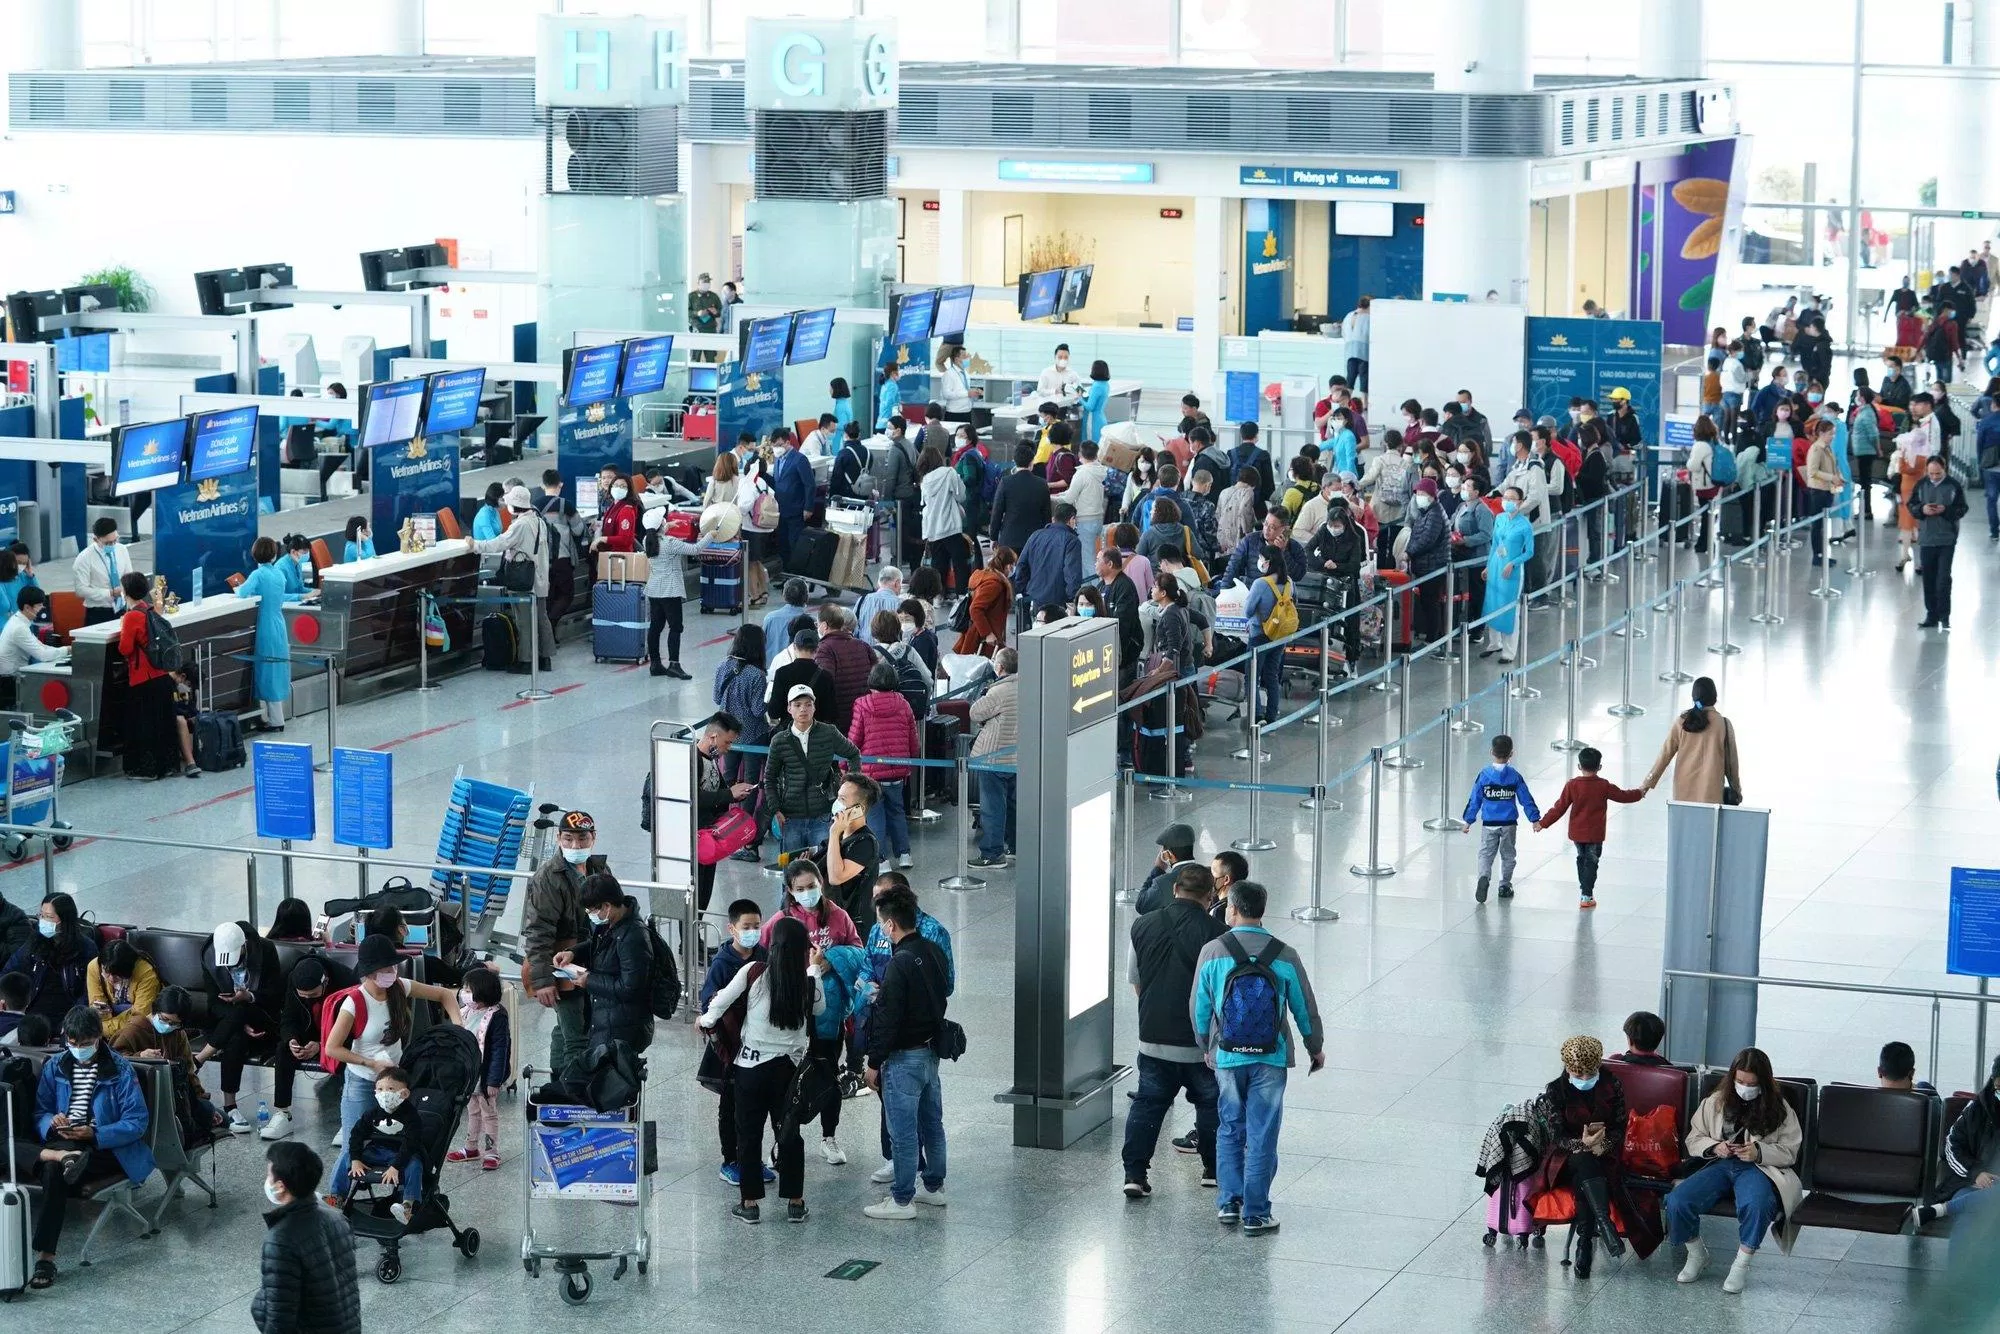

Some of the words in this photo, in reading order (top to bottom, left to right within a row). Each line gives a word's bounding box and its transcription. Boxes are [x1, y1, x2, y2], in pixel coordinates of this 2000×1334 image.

[565, 30, 610, 91] H
[771, 32, 826, 97] G
[1293, 171, 1325, 186] Phòng
[1326, 172, 1339, 184] vé
[1345, 174, 1368, 185] Ticket
[1368, 175, 1390, 186] office
[1072, 667, 1101, 688] Departure
